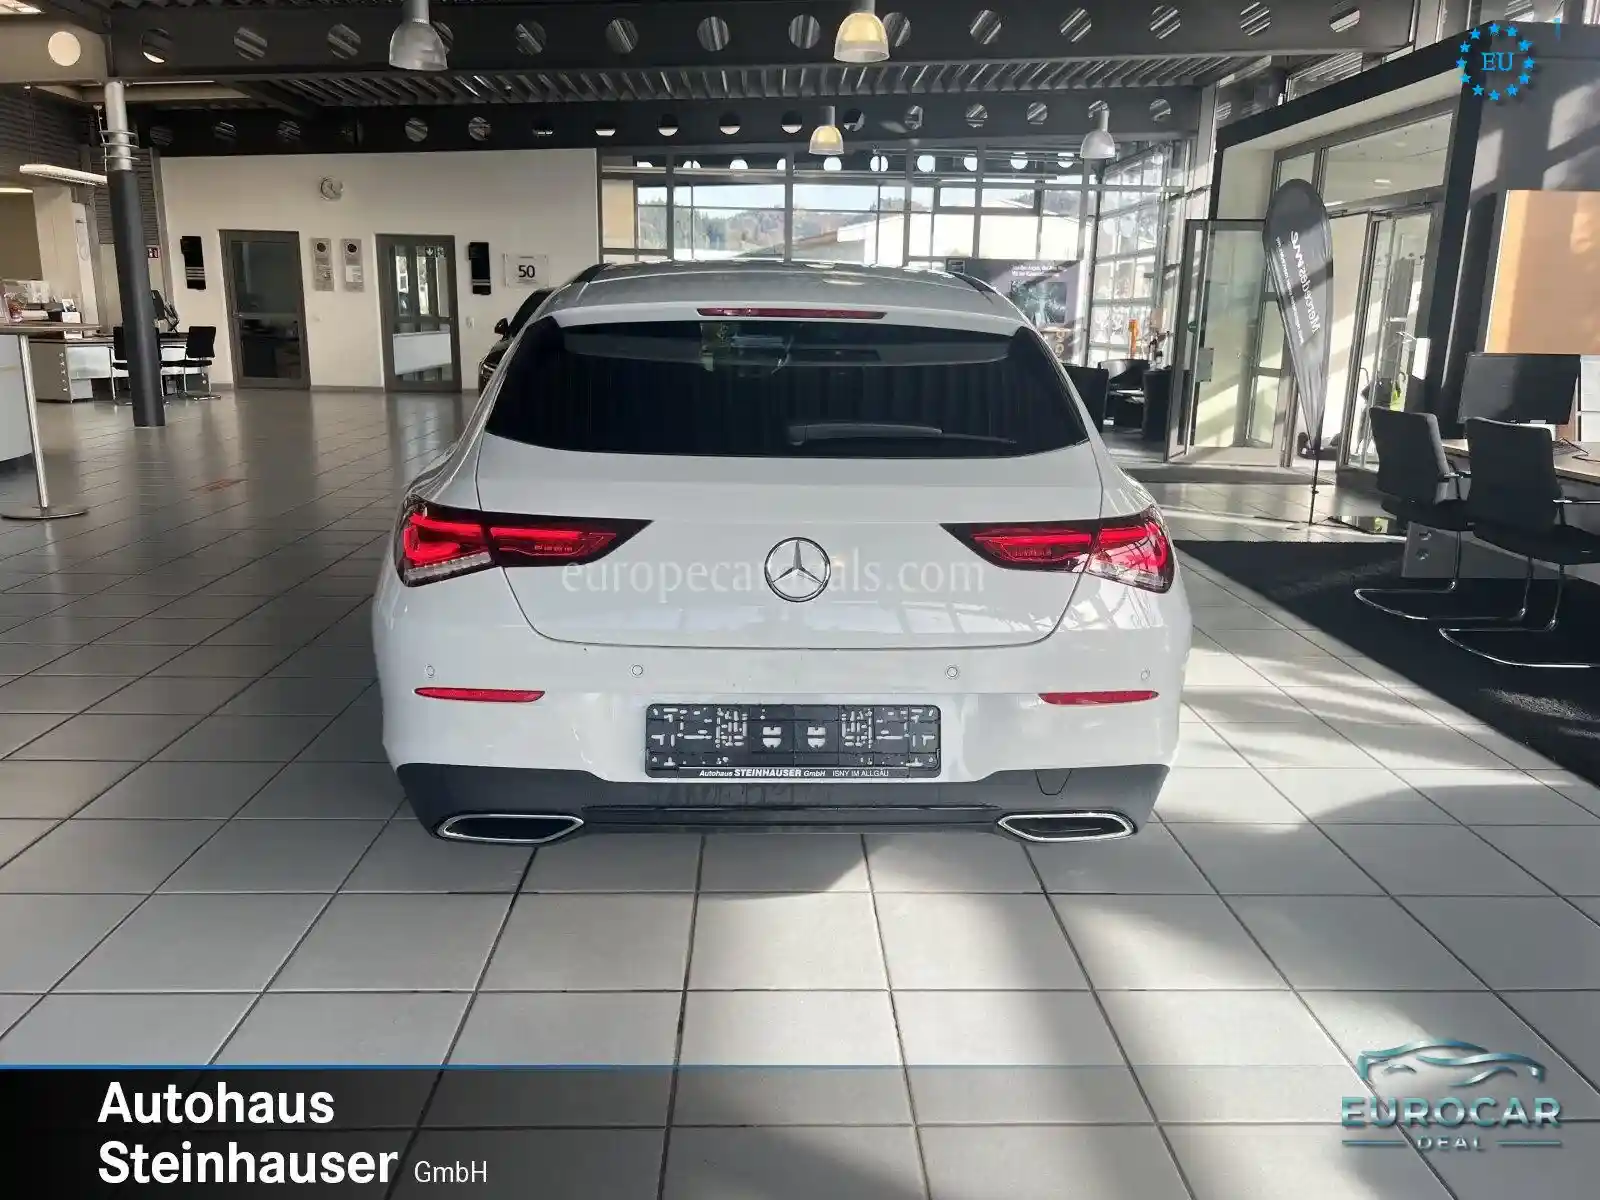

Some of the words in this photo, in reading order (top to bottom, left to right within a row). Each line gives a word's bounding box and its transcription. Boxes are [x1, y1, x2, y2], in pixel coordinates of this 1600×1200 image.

[518, 264, 536, 278] 50
[699, 769, 733, 777] Autohaus
[734, 768, 802, 777] STEINHAUSER
[803, 769, 826, 777] GmbH
[832, 769, 849, 777] ISNY
[851, 769, 860, 777] IM
